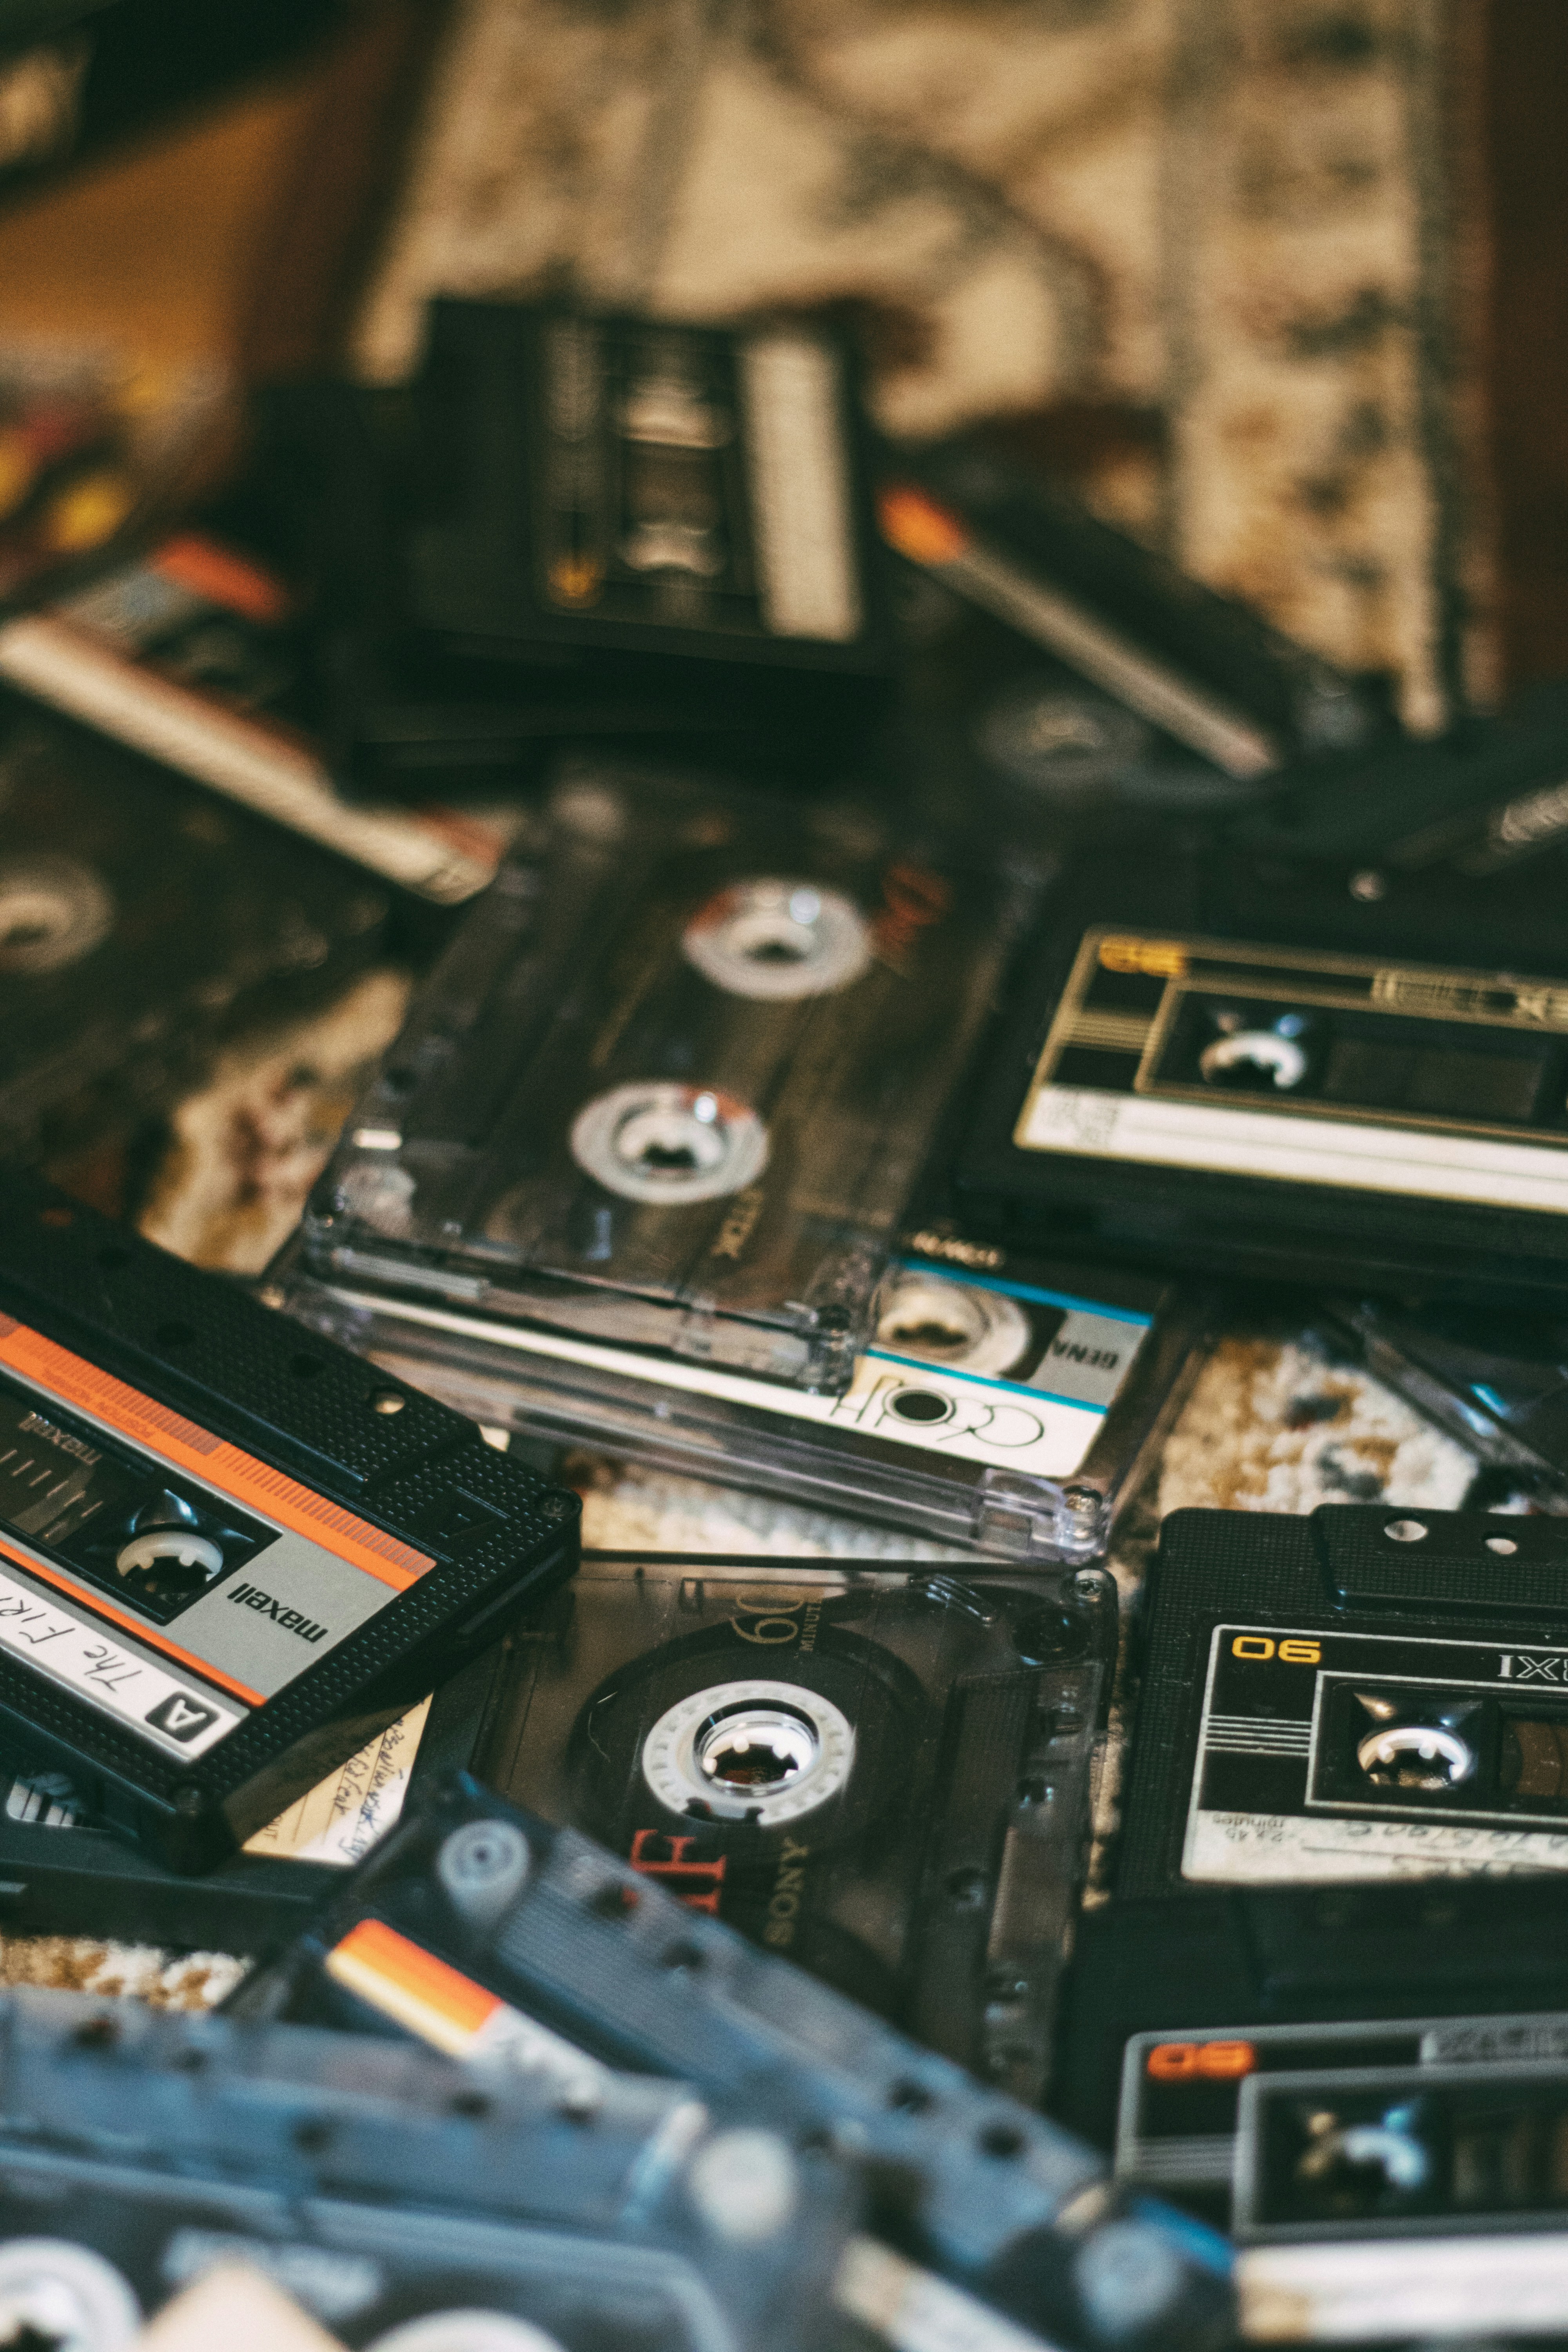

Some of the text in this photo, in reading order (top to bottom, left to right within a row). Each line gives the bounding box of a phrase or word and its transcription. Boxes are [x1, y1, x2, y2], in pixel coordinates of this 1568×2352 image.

[227, 1583, 328, 1643] maxell
[0, 1595, 143, 1693] The FIR
[1496, 1654, 1568, 1682] XI
[165, 1698, 208, 1730] A
[764, 1835, 811, 1945] SONY
